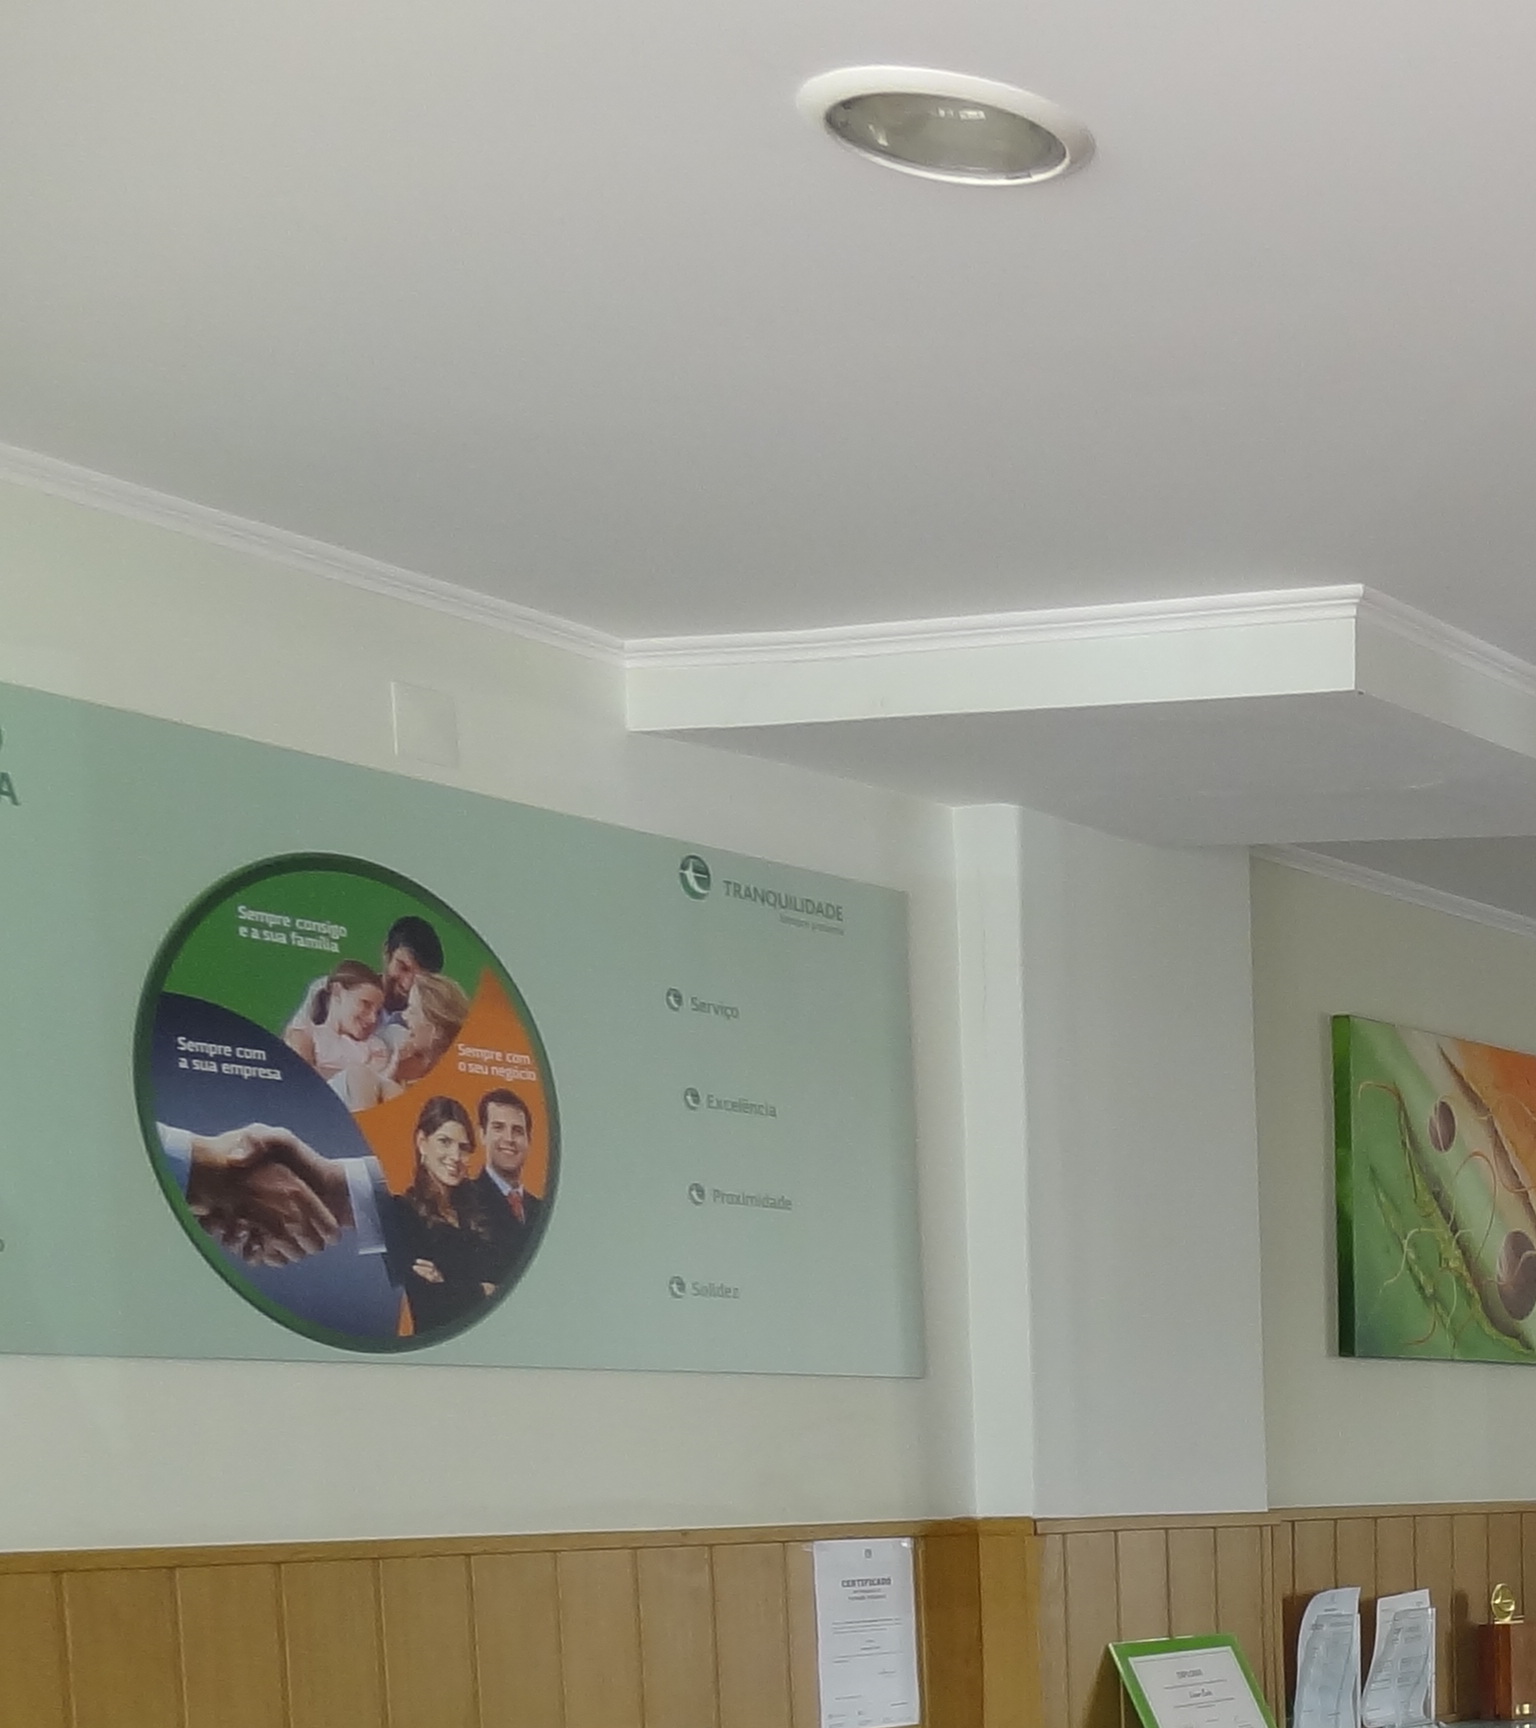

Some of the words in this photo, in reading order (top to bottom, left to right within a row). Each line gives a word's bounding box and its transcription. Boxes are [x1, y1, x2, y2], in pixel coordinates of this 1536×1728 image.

[723, 879, 844, 922] TRANQUILIDADE
[237, 905, 291, 928] Sempre
[295, 918, 348, 940] consigo
[238, 926, 249, 938] e
[251, 928, 261, 940] a
[263, 930, 288, 945] sua
[690, 996, 740, 1020] Serviço
[177, 1036, 233, 1057] Sempre
[235, 1047, 267, 1061] com
[457, 1043, 503, 1062] Sempre
[505, 1052, 531, 1065] com
[178, 1057, 190, 1069] a
[192, 1059, 218, 1073] sua
[221, 1063, 283, 1081] empresa
[457, 1061, 467, 1072] o
[468, 1063, 489, 1075] seu
[490, 1065, 537, 1082] negócio
[706, 1094, 778, 1119] Excelência
[712, 1188, 793, 1212] Proximidade
[691, 1281, 740, 1300] Solidez
[841, 1577, 892, 1588] CERTIFICADO
